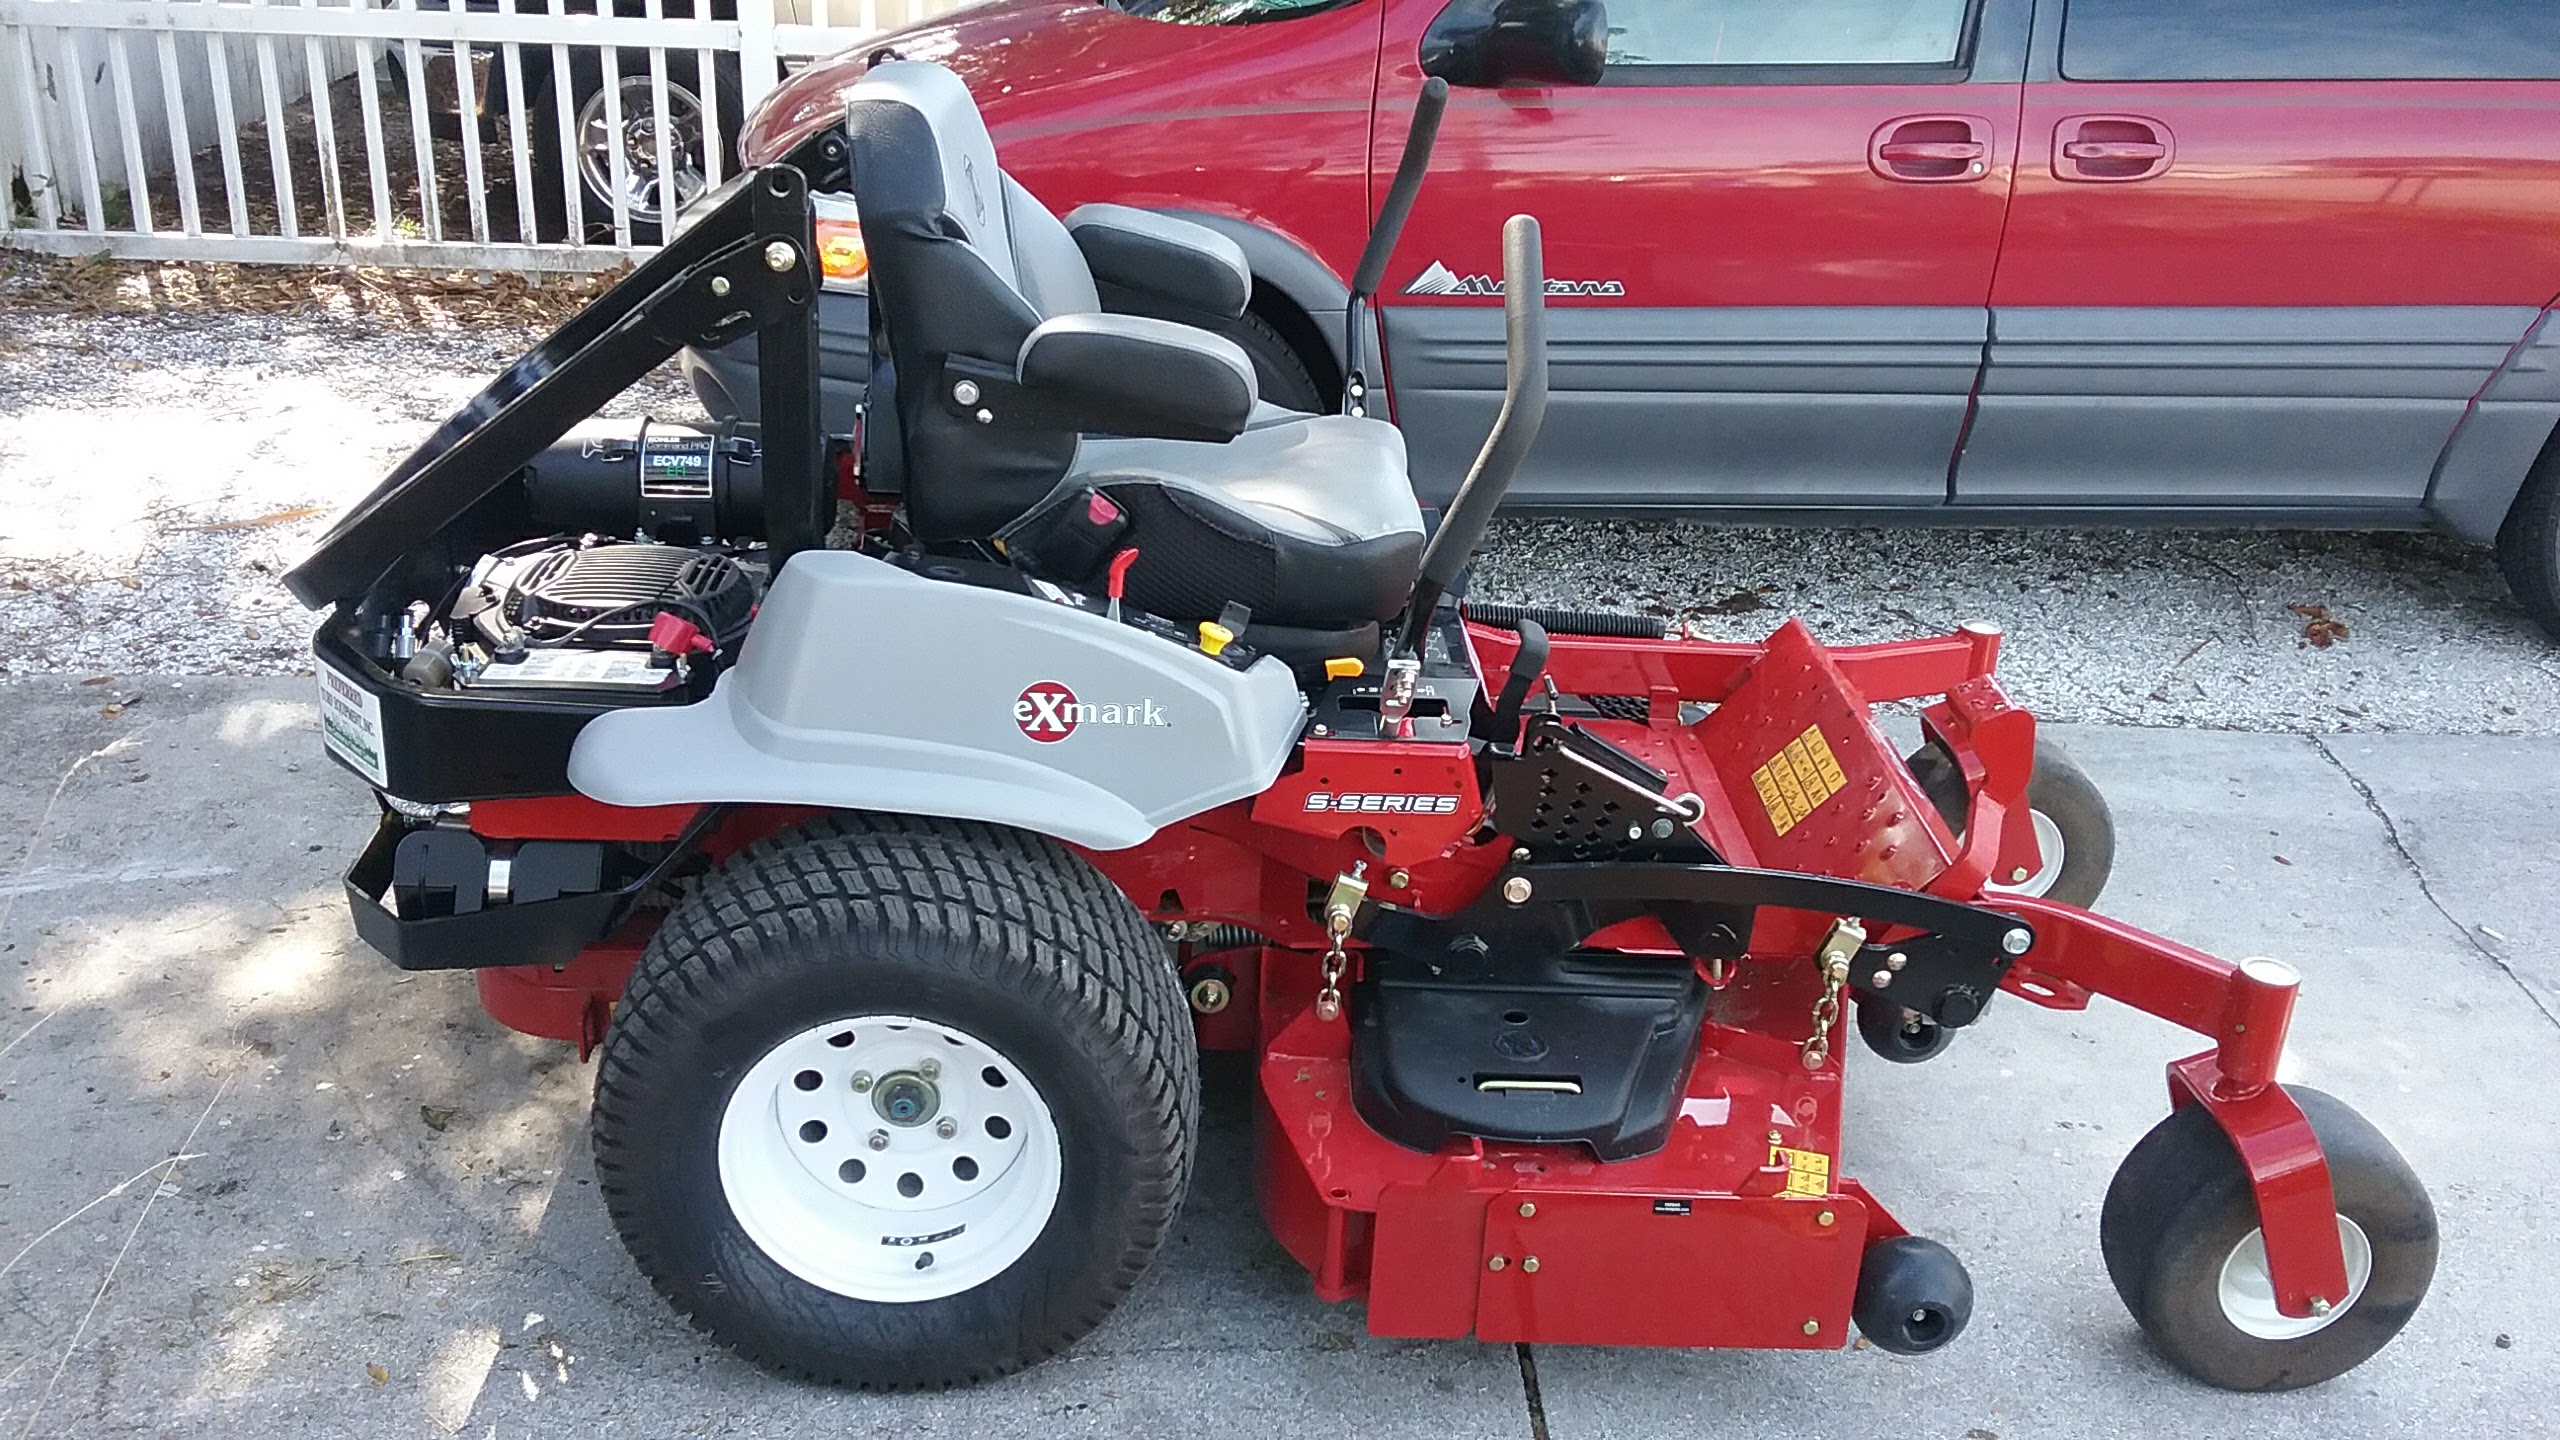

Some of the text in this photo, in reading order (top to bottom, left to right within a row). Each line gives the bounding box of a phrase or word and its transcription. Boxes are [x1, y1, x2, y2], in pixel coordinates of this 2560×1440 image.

[1449, 274, 1625, 296] Mtana
[690, 441, 710, 450] PRO
[653, 455, 702, 467] ECV749
[667, 466, 686, 477] EFI
[1304, 792, 1461, 814] S-SERIES
